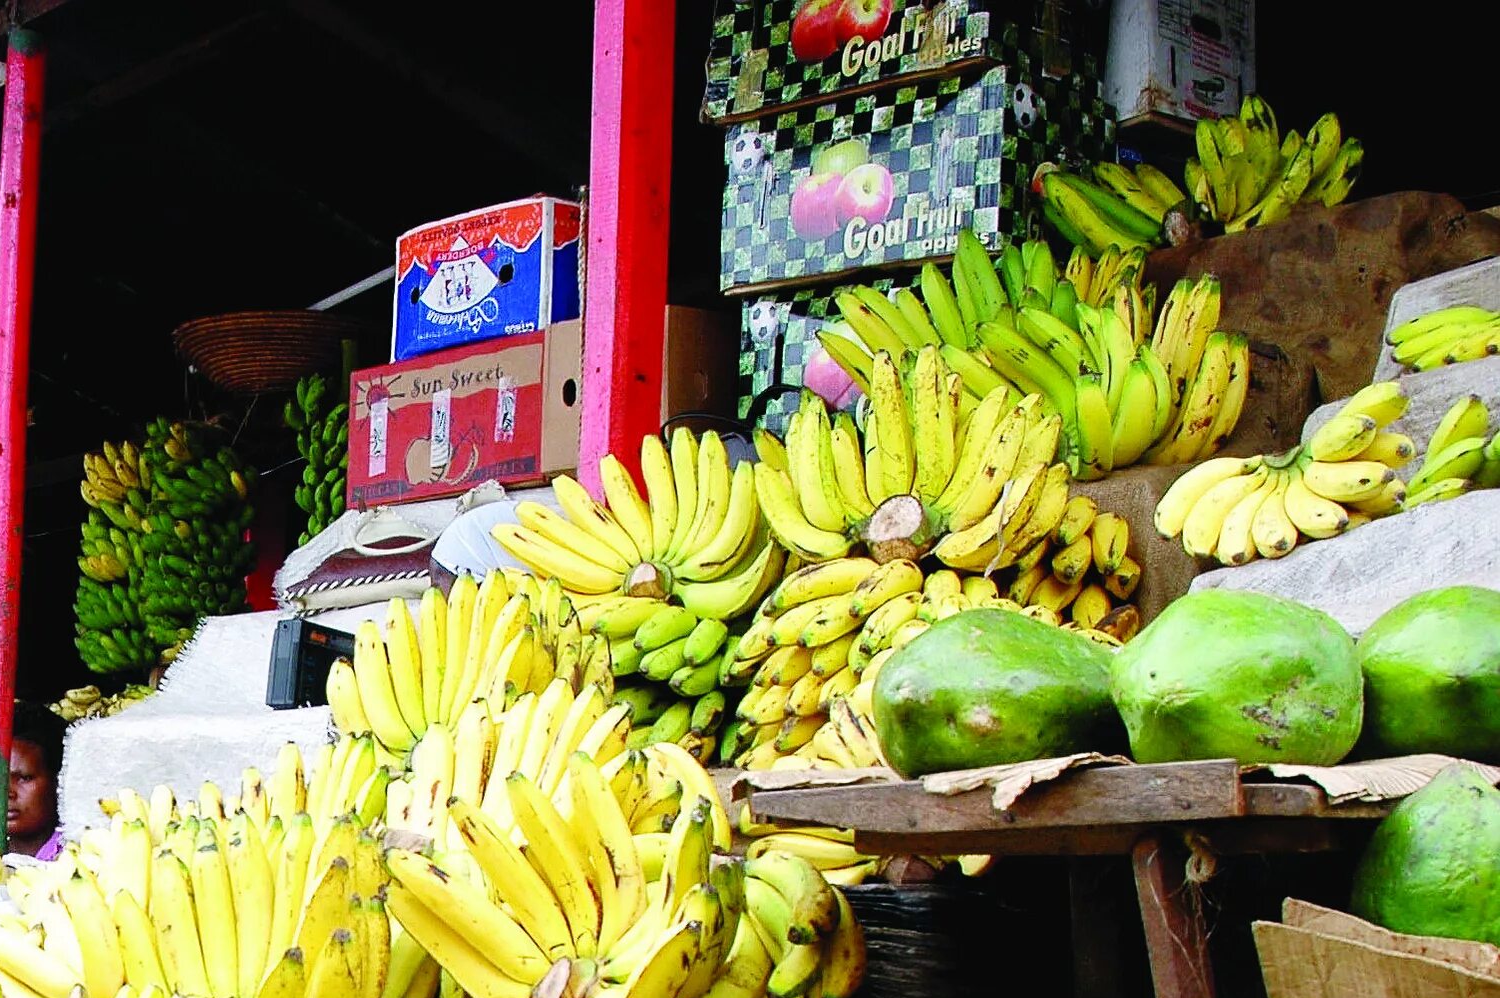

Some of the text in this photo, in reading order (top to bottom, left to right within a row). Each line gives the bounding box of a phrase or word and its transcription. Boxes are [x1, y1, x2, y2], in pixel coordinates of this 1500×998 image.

[841, 17, 906, 78] Goal
[843, 203, 909, 260] Goal
[917, 193, 966, 238] Fruit
[920, 233, 990, 252] apps
[411, 364, 504, 397] Sun Sweet
